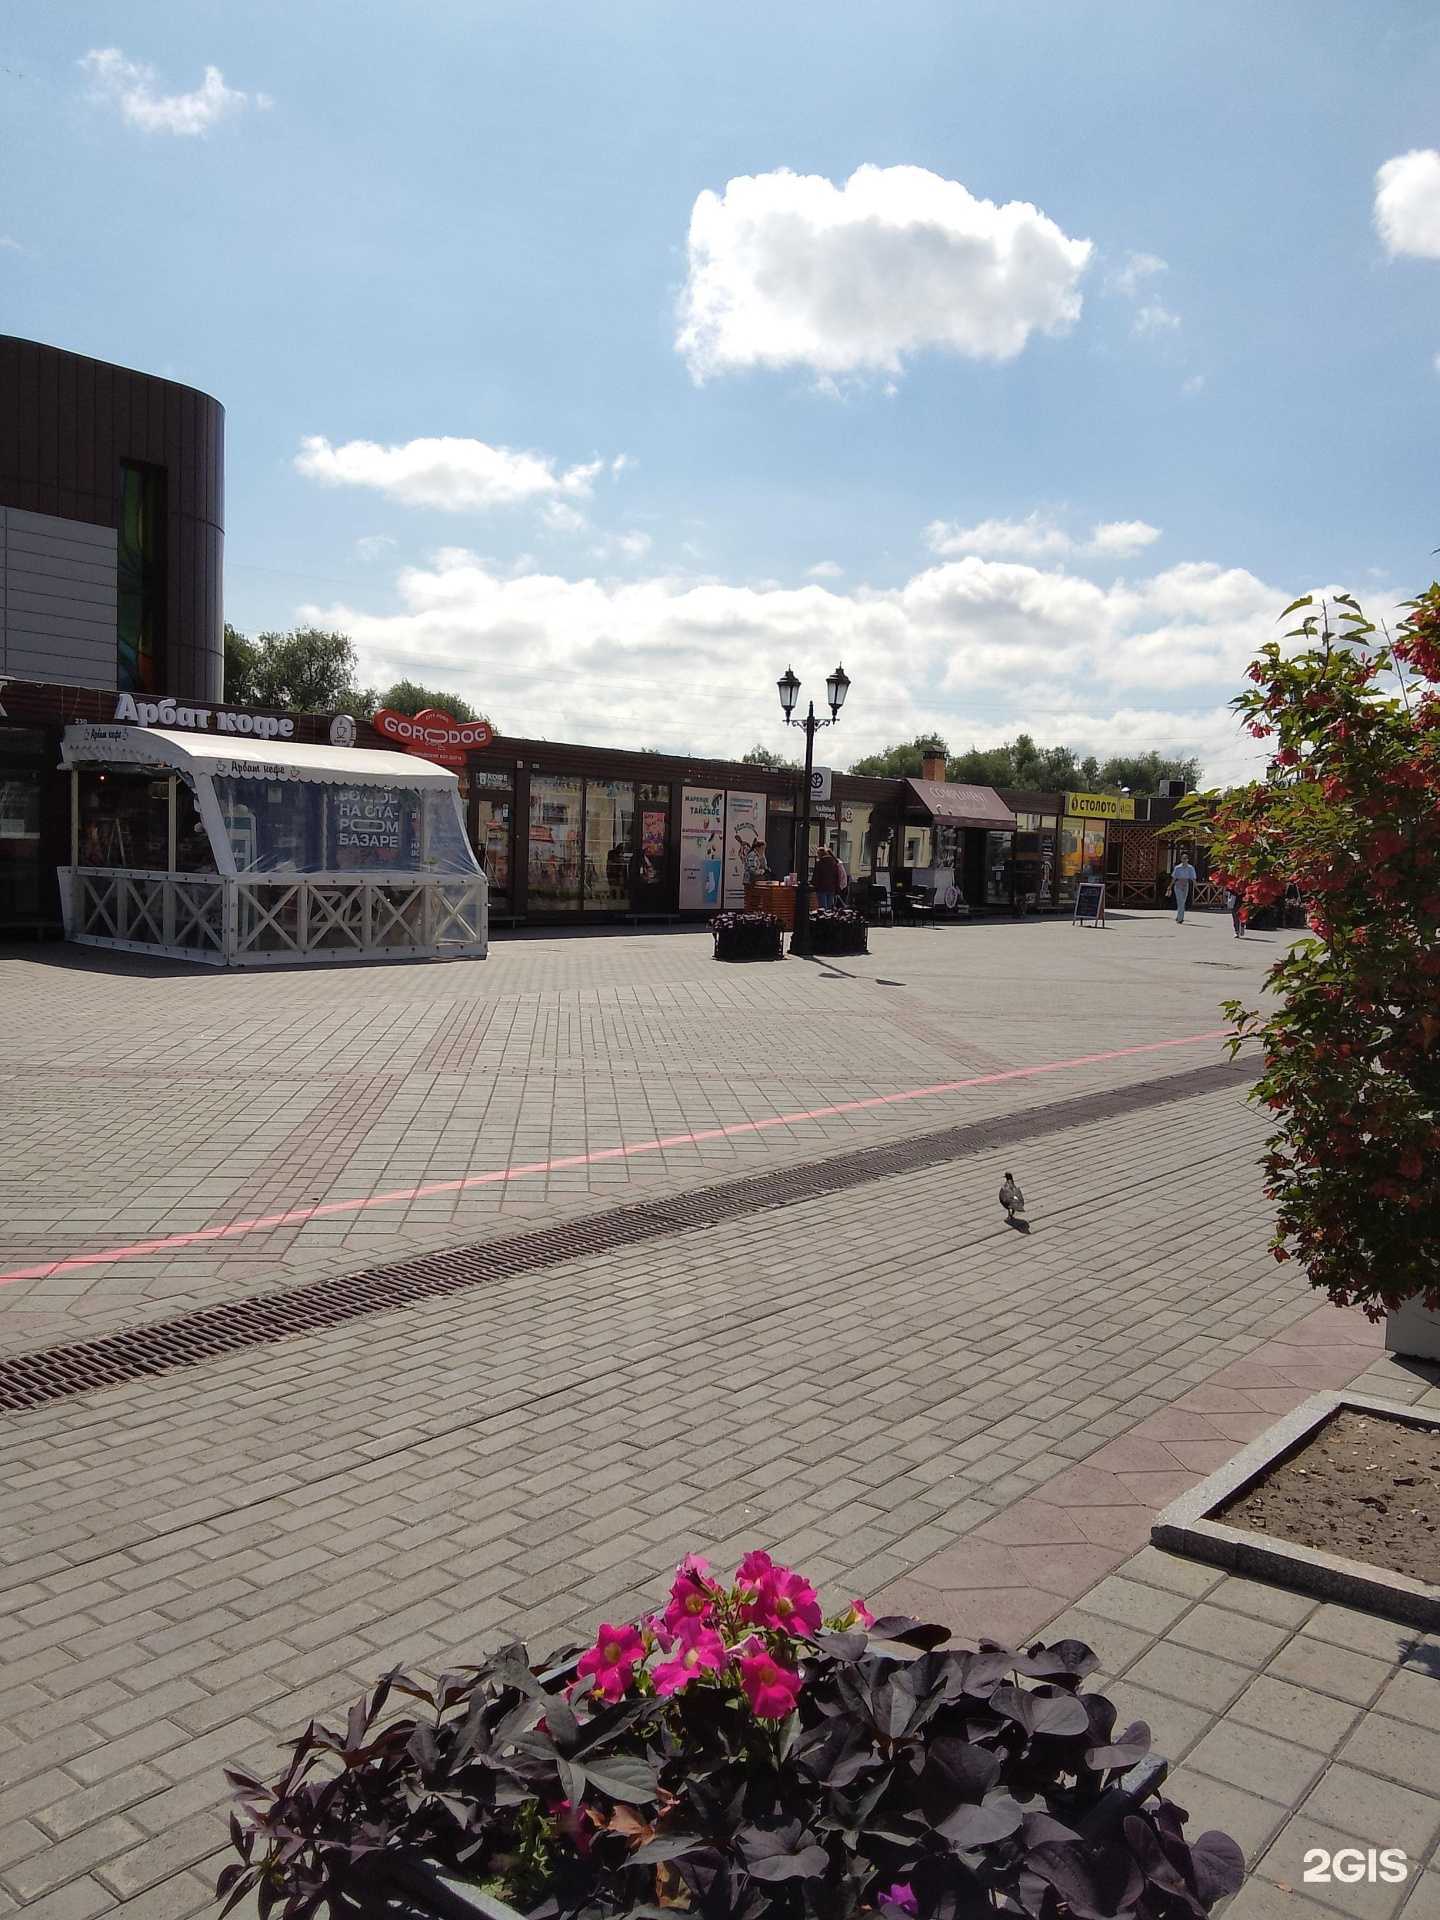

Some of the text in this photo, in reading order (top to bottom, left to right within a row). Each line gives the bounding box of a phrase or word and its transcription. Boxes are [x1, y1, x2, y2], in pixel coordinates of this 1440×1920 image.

[114, 693, 294, 739] Арбат кофе
[339, 803, 362, 817] НА
[1079, 800, 1117, 813] СТОЛОТО
[339, 832, 400, 848] БАЗАРЕ
